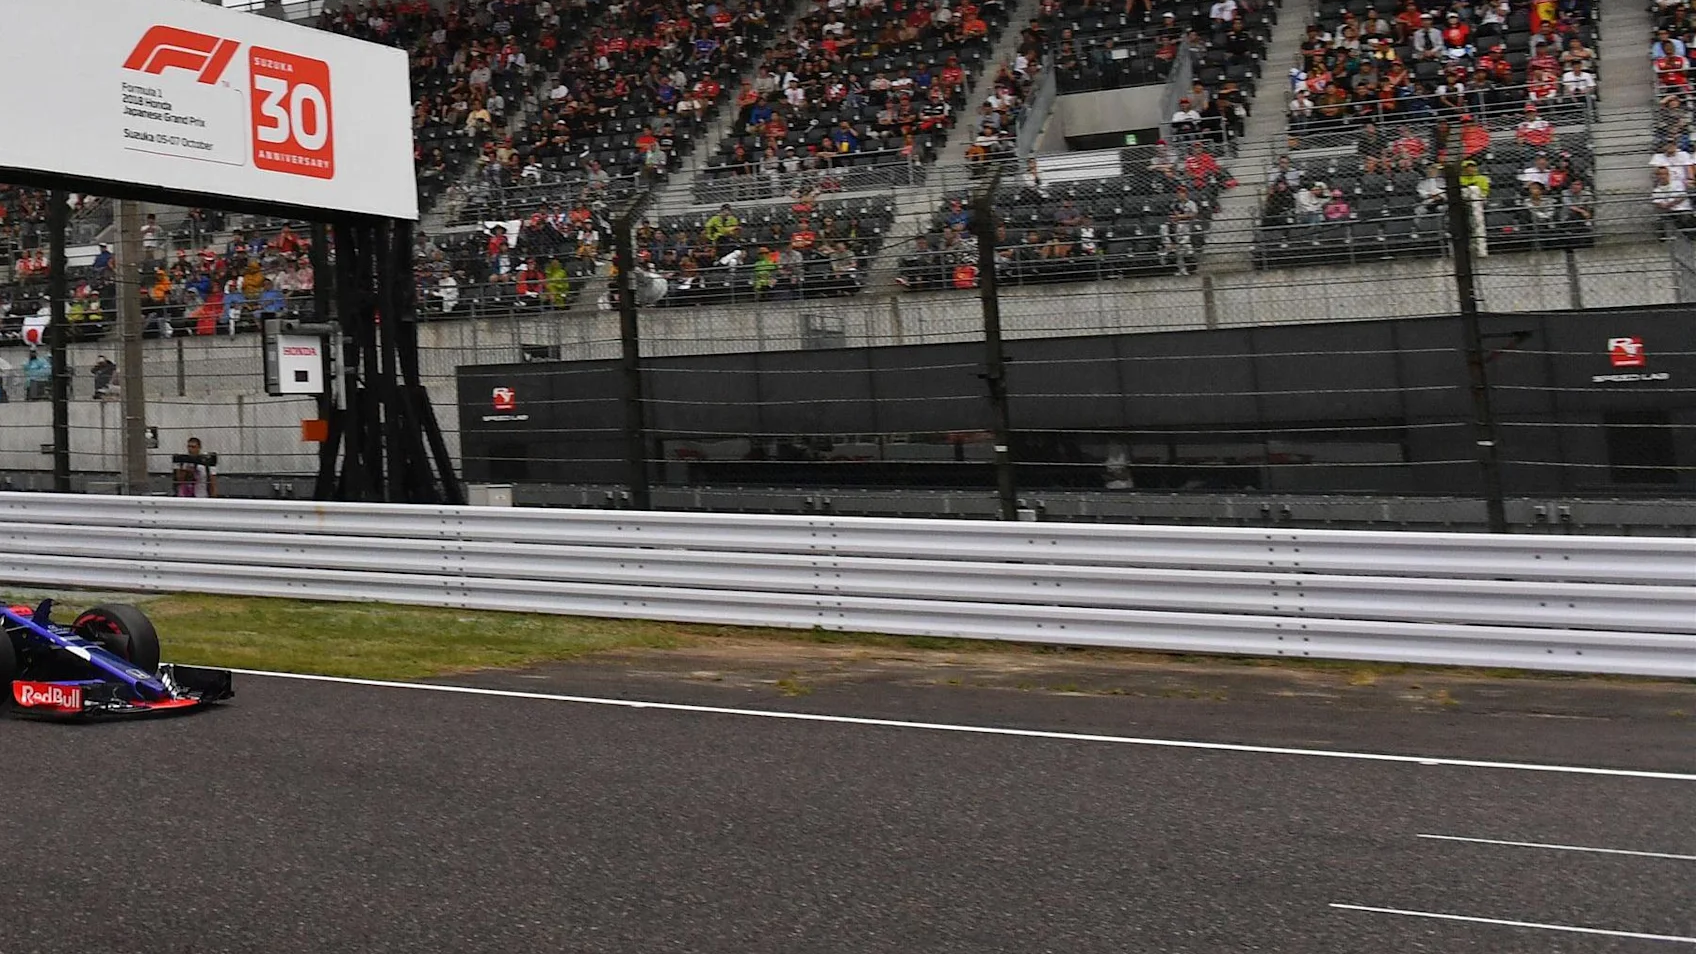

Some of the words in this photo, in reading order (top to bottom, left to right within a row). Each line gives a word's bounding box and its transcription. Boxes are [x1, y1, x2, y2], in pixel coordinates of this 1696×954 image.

[254, 57, 294, 73] SUZUKA
[122, 82, 156, 98] Formula
[157, 88, 163, 98] 1
[122, 93, 144, 106] 2018
[145, 97, 172, 111] Honda
[123, 106, 163, 122] Japanese
[164, 112, 188, 125] Grand
[189, 116, 206, 127] Prix
[254, 74, 329, 151] 30
[123, 128, 154, 142] Suzuka
[156, 133, 180, 146] 05-07
[181, 137, 214, 151] October
[258, 150, 329, 168] ANNIVERSARY
[282, 346, 318, 356] HONDA
